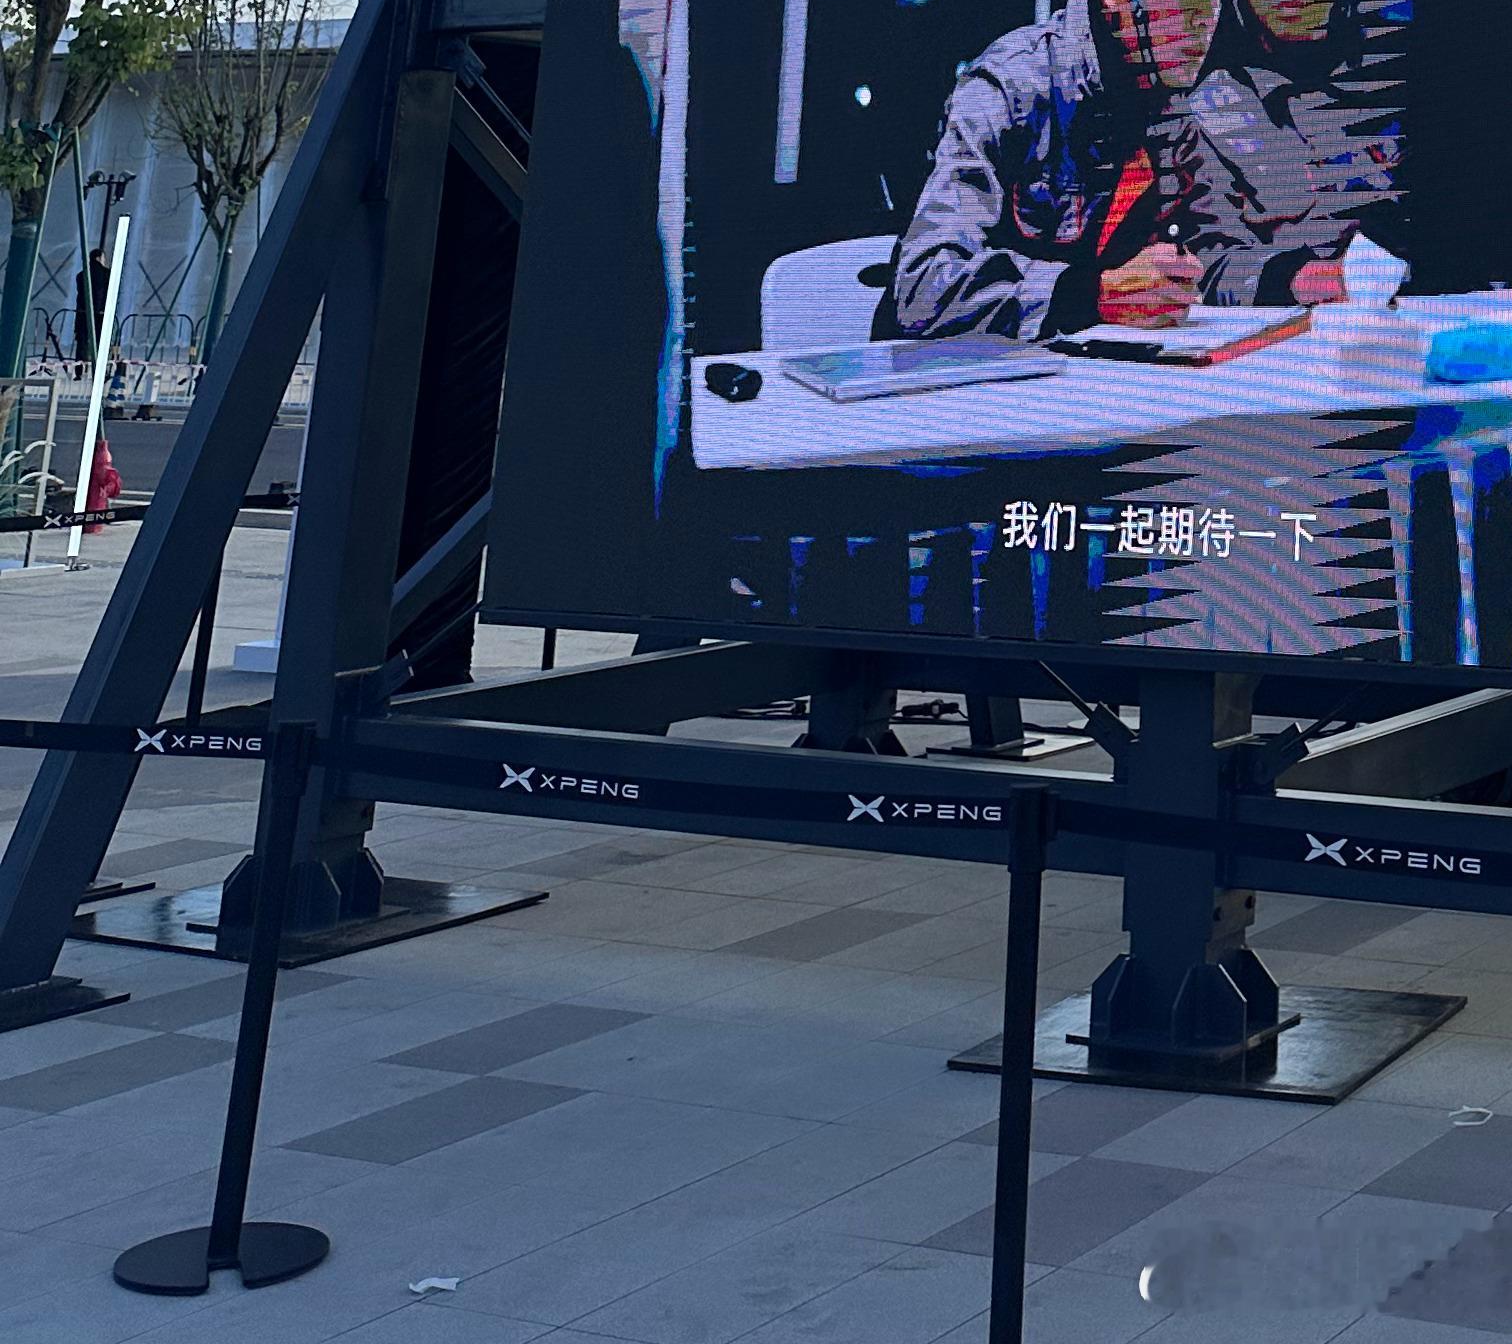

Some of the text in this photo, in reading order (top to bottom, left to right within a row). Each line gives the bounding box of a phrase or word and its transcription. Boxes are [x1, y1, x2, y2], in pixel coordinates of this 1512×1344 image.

[64, 511, 116, 524] XPENG
[1002, 500, 1318, 562] 我们一起期待一下
[171, 734, 262, 751] XPENG
[539, 773, 640, 800] XPENG
[891, 802, 1002, 821] XPENG
[1355, 846, 1481, 874] XPENG
